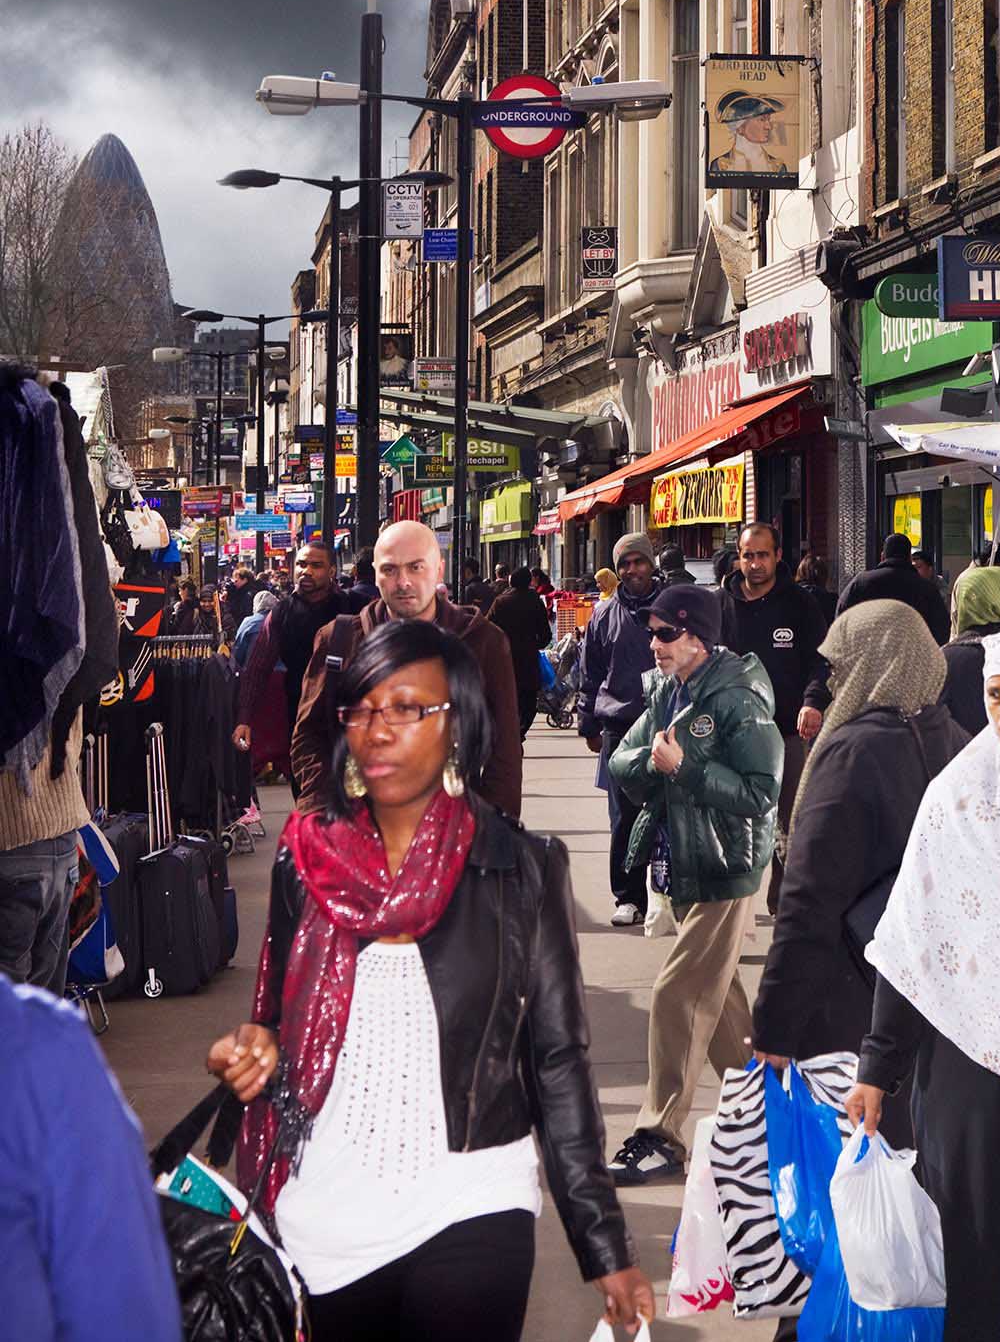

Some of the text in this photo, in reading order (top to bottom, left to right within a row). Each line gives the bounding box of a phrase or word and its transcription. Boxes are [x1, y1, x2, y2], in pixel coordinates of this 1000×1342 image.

[739, 71, 766, 81] HEAD
[481, 112, 572, 123] UNDERGROUND
[387, 184, 421, 195] CCTV
